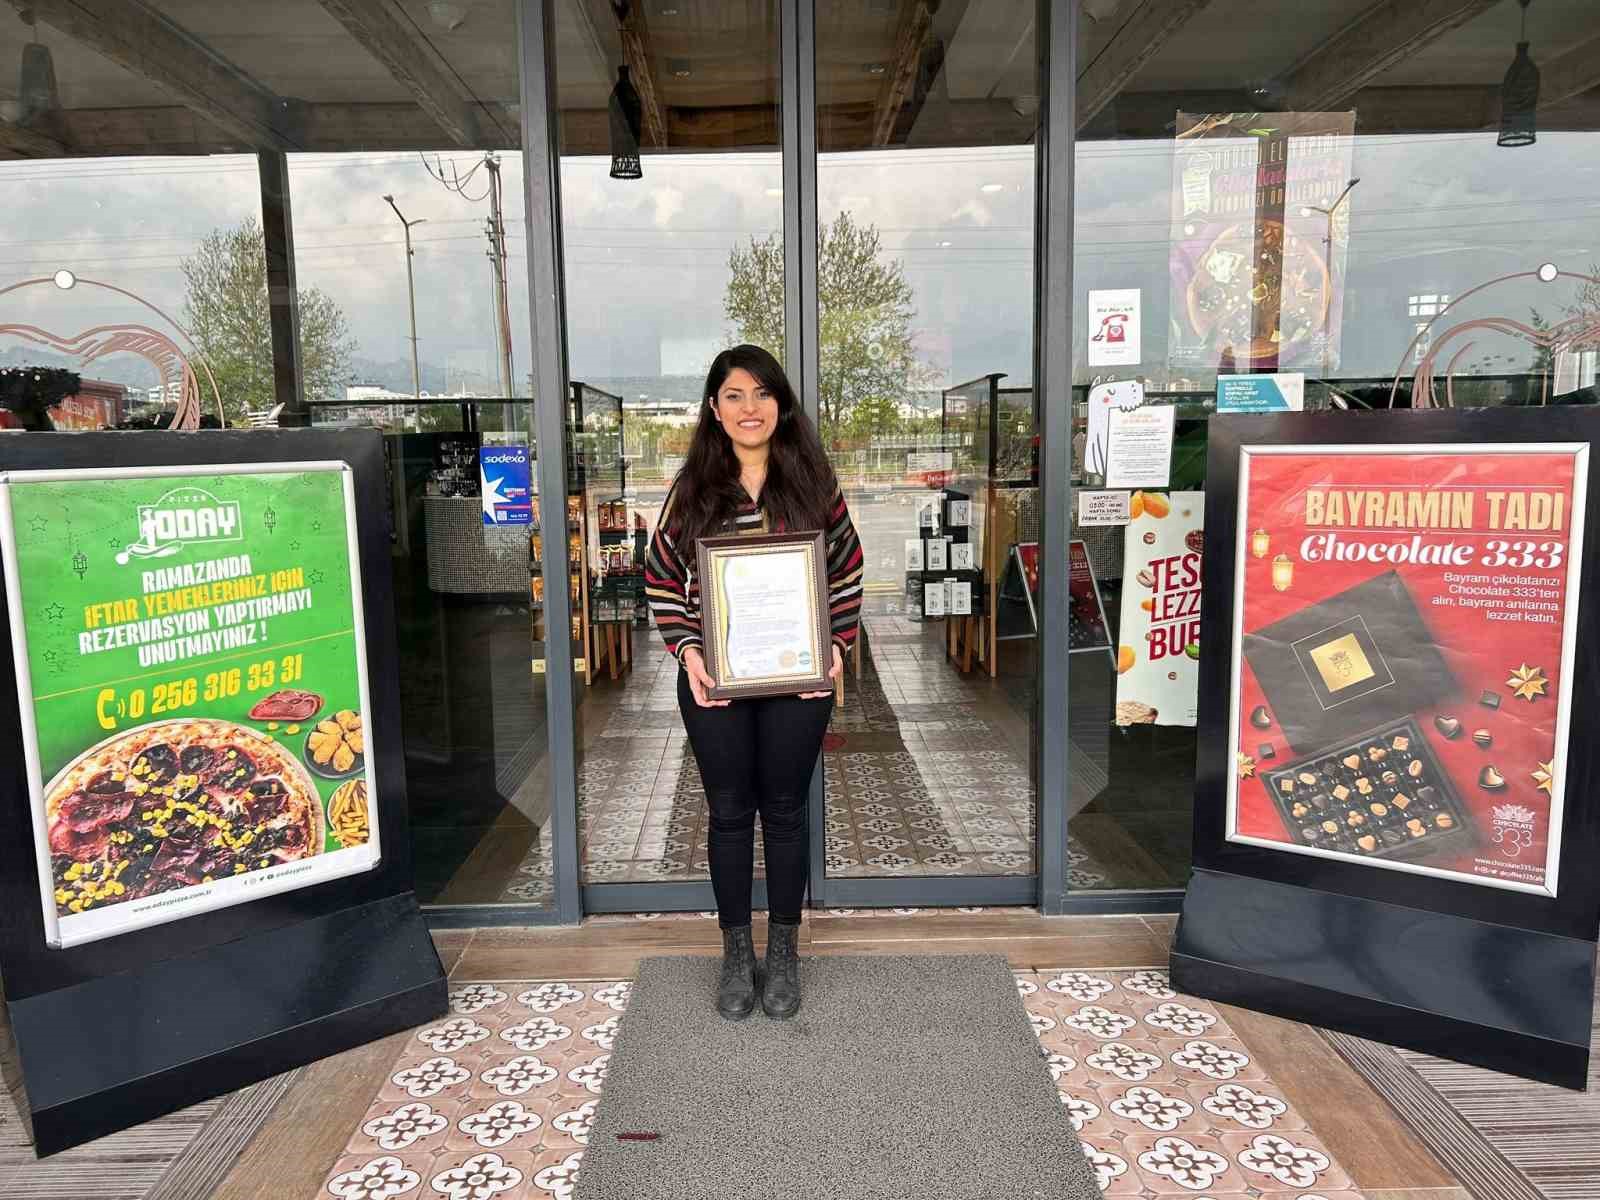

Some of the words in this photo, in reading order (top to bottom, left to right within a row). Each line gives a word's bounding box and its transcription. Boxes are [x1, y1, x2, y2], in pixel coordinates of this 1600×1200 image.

[484, 450, 525, 463] sodexo
[1305, 490, 1475, 529] BAYRAMIN
[1486, 491, 1564, 531] TADI
[1300, 533, 1475, 566] Chocolate
[1481, 540, 1564, 569] 333
[142, 554, 252, 594] RAMAZANDA
[1148, 553, 1204, 595] TES
[1443, 572, 1489, 585] Bayram
[1448, 584, 1510, 597] Chocolate
[1512, 587, 1560, 599] 333'ten
[1459, 596, 1504, 609] bayram
[1486, 610, 1522, 622] lezzet
[78, 609, 211, 656] REZERVASYON
[213, 588, 312, 627] YAPTIRMAYI
[138, 622, 257, 668] UNUTMAYINIZ
[128, 688, 145, 719] 0
[151, 677, 198, 715] 256
[203, 667, 241, 702] 316
[247, 660, 276, 692] 33
[280, 653, 304, 683] 31
[1492, 819, 1534, 830] CHOCOLATE
